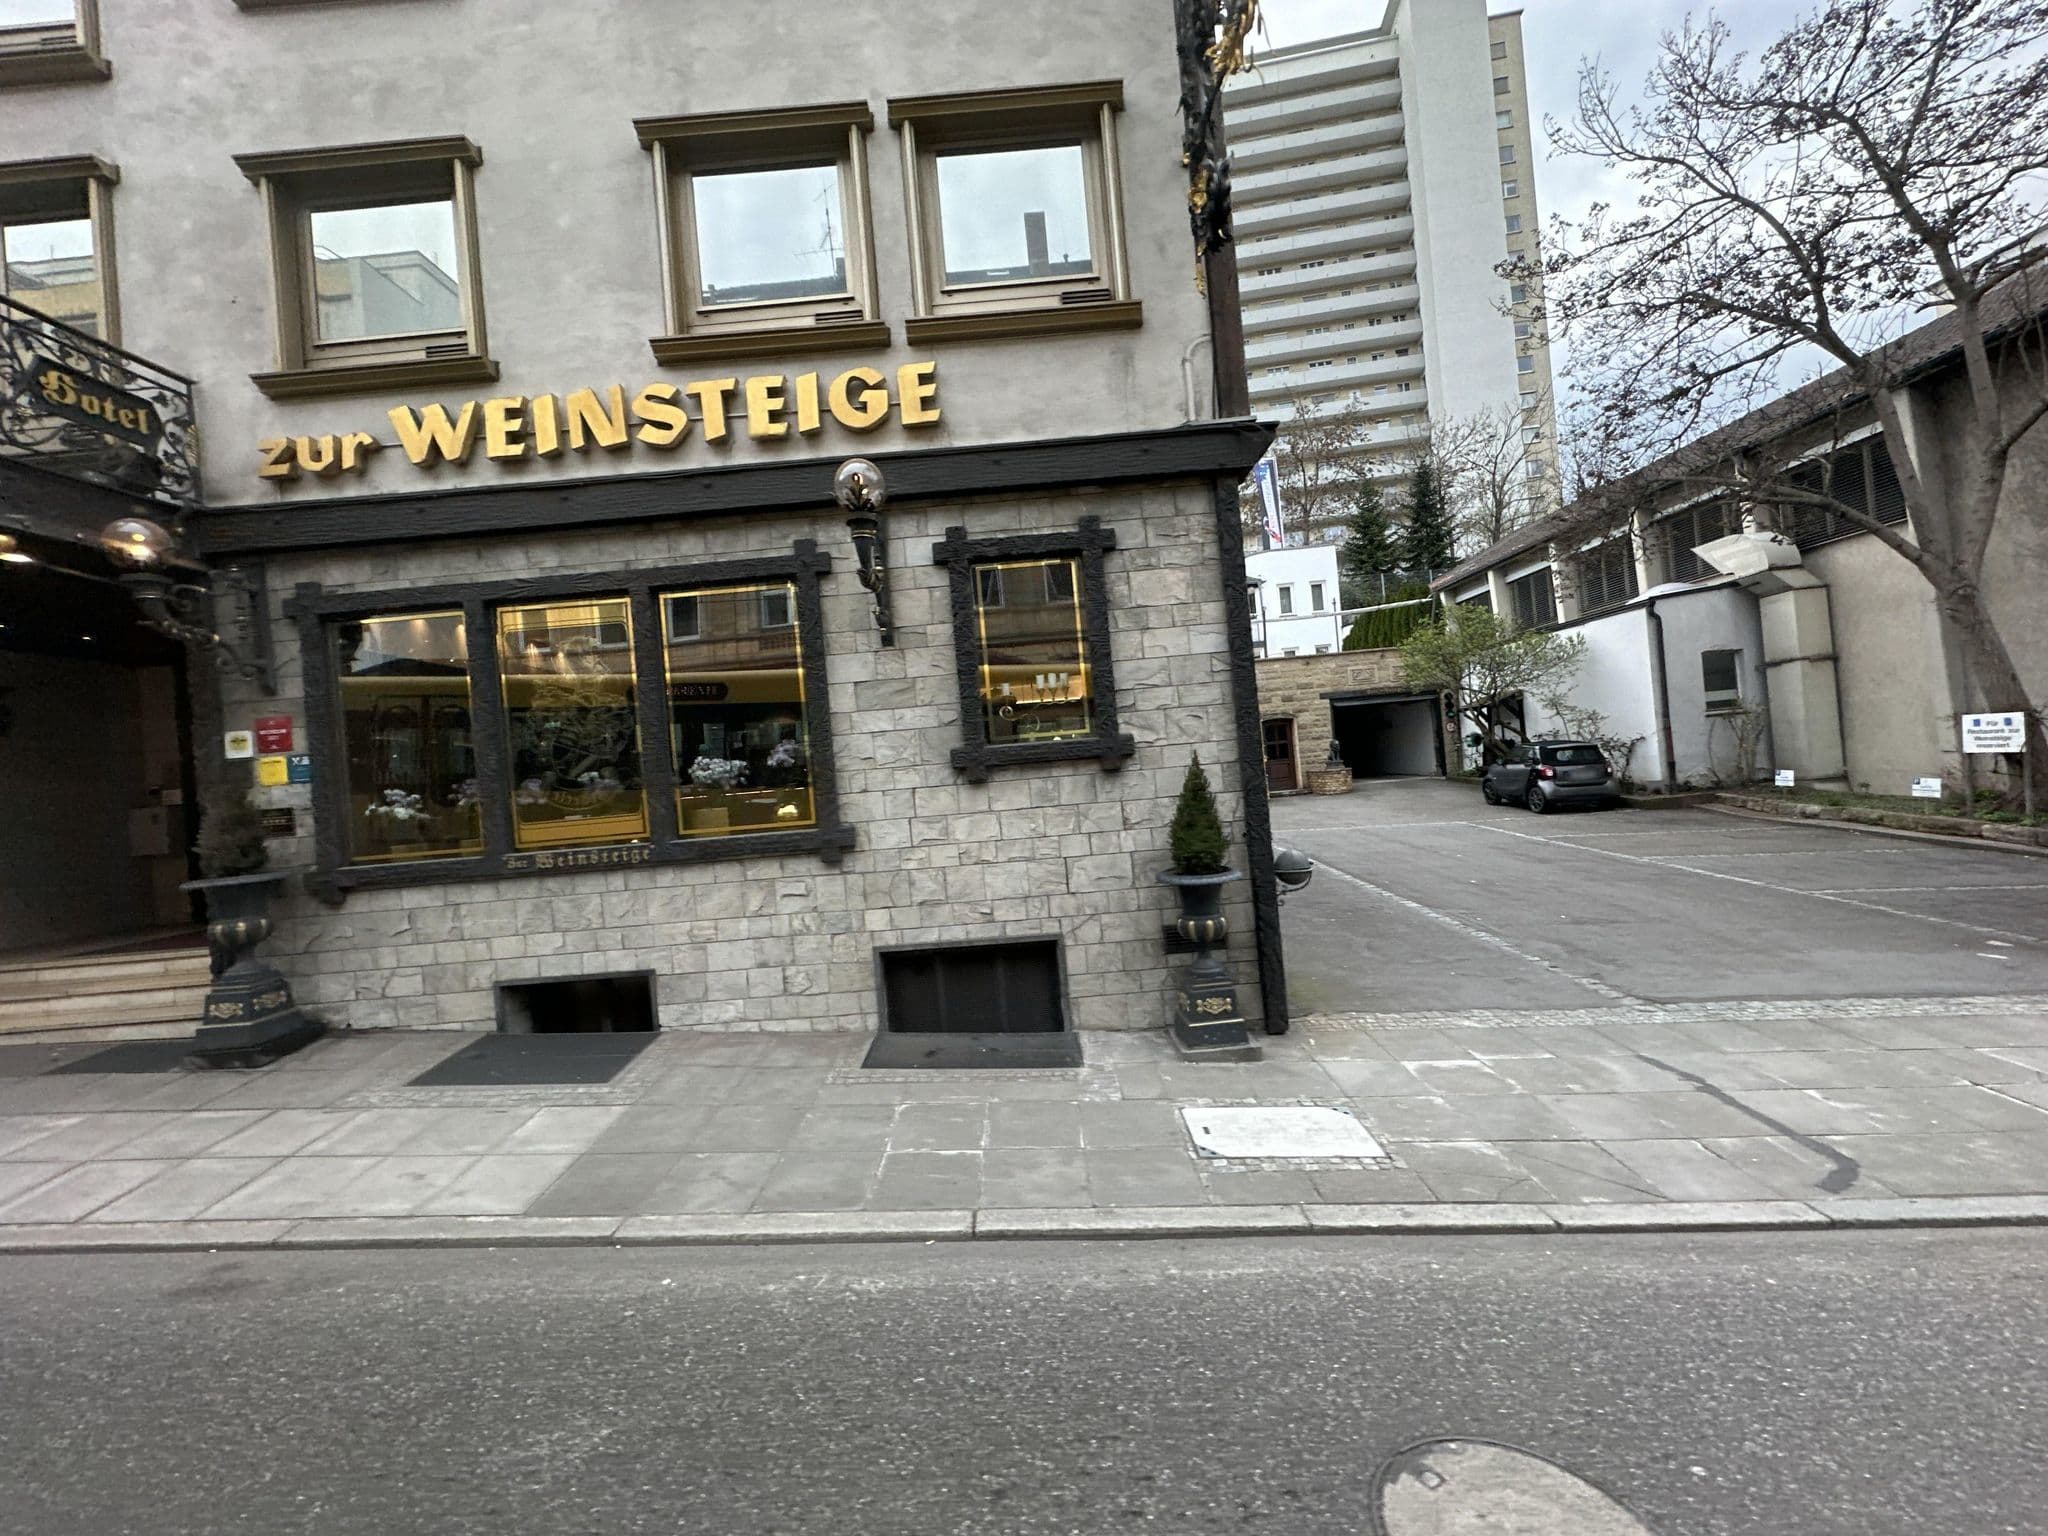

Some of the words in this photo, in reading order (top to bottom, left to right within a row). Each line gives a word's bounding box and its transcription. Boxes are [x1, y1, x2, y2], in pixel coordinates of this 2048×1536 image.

[38, 370, 149, 434] Hotel
[258, 432, 370, 478] zur
[387, 361, 942, 463] WEINSTEIGE
